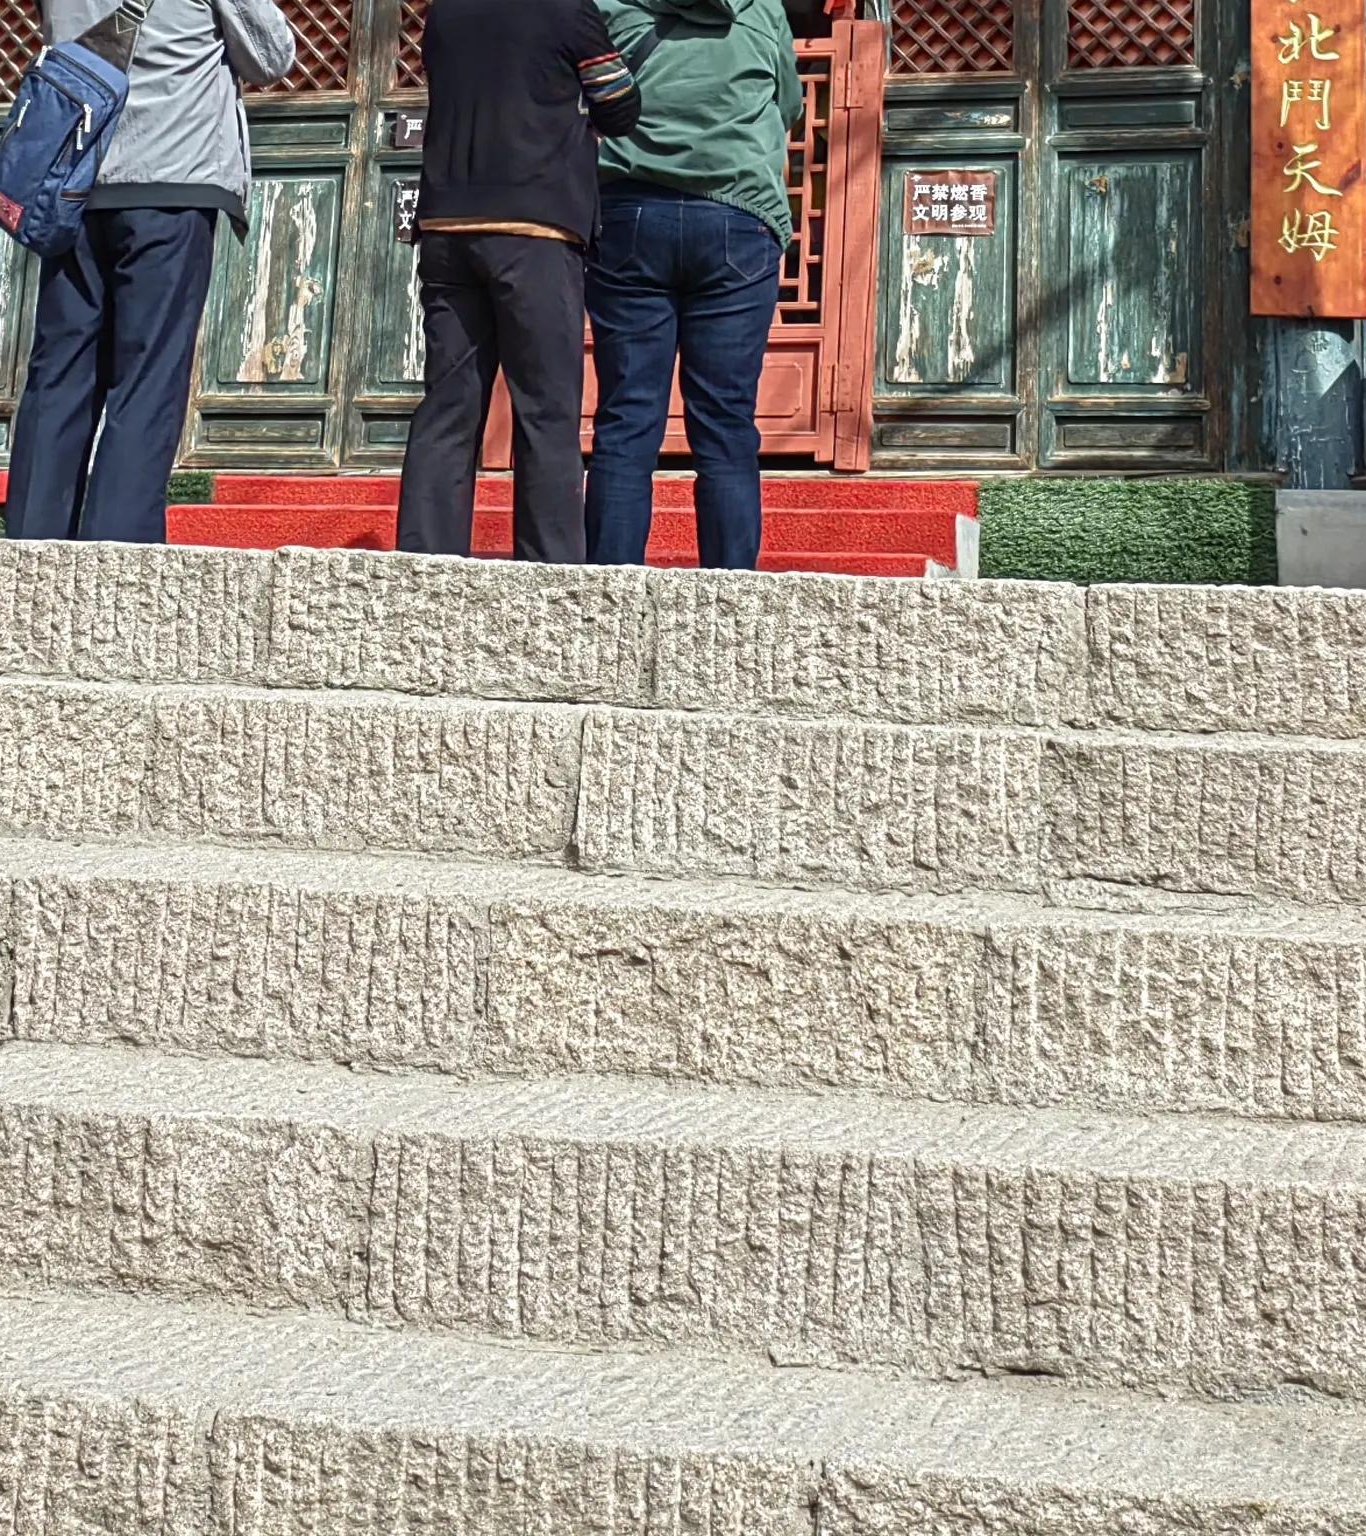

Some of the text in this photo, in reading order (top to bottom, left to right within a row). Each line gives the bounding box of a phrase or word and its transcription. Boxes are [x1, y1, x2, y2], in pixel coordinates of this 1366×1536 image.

[913, 184, 988, 201] 严禁燃香
[399, 211, 416, 230] 文
[912, 204, 988, 222] 文明参观
